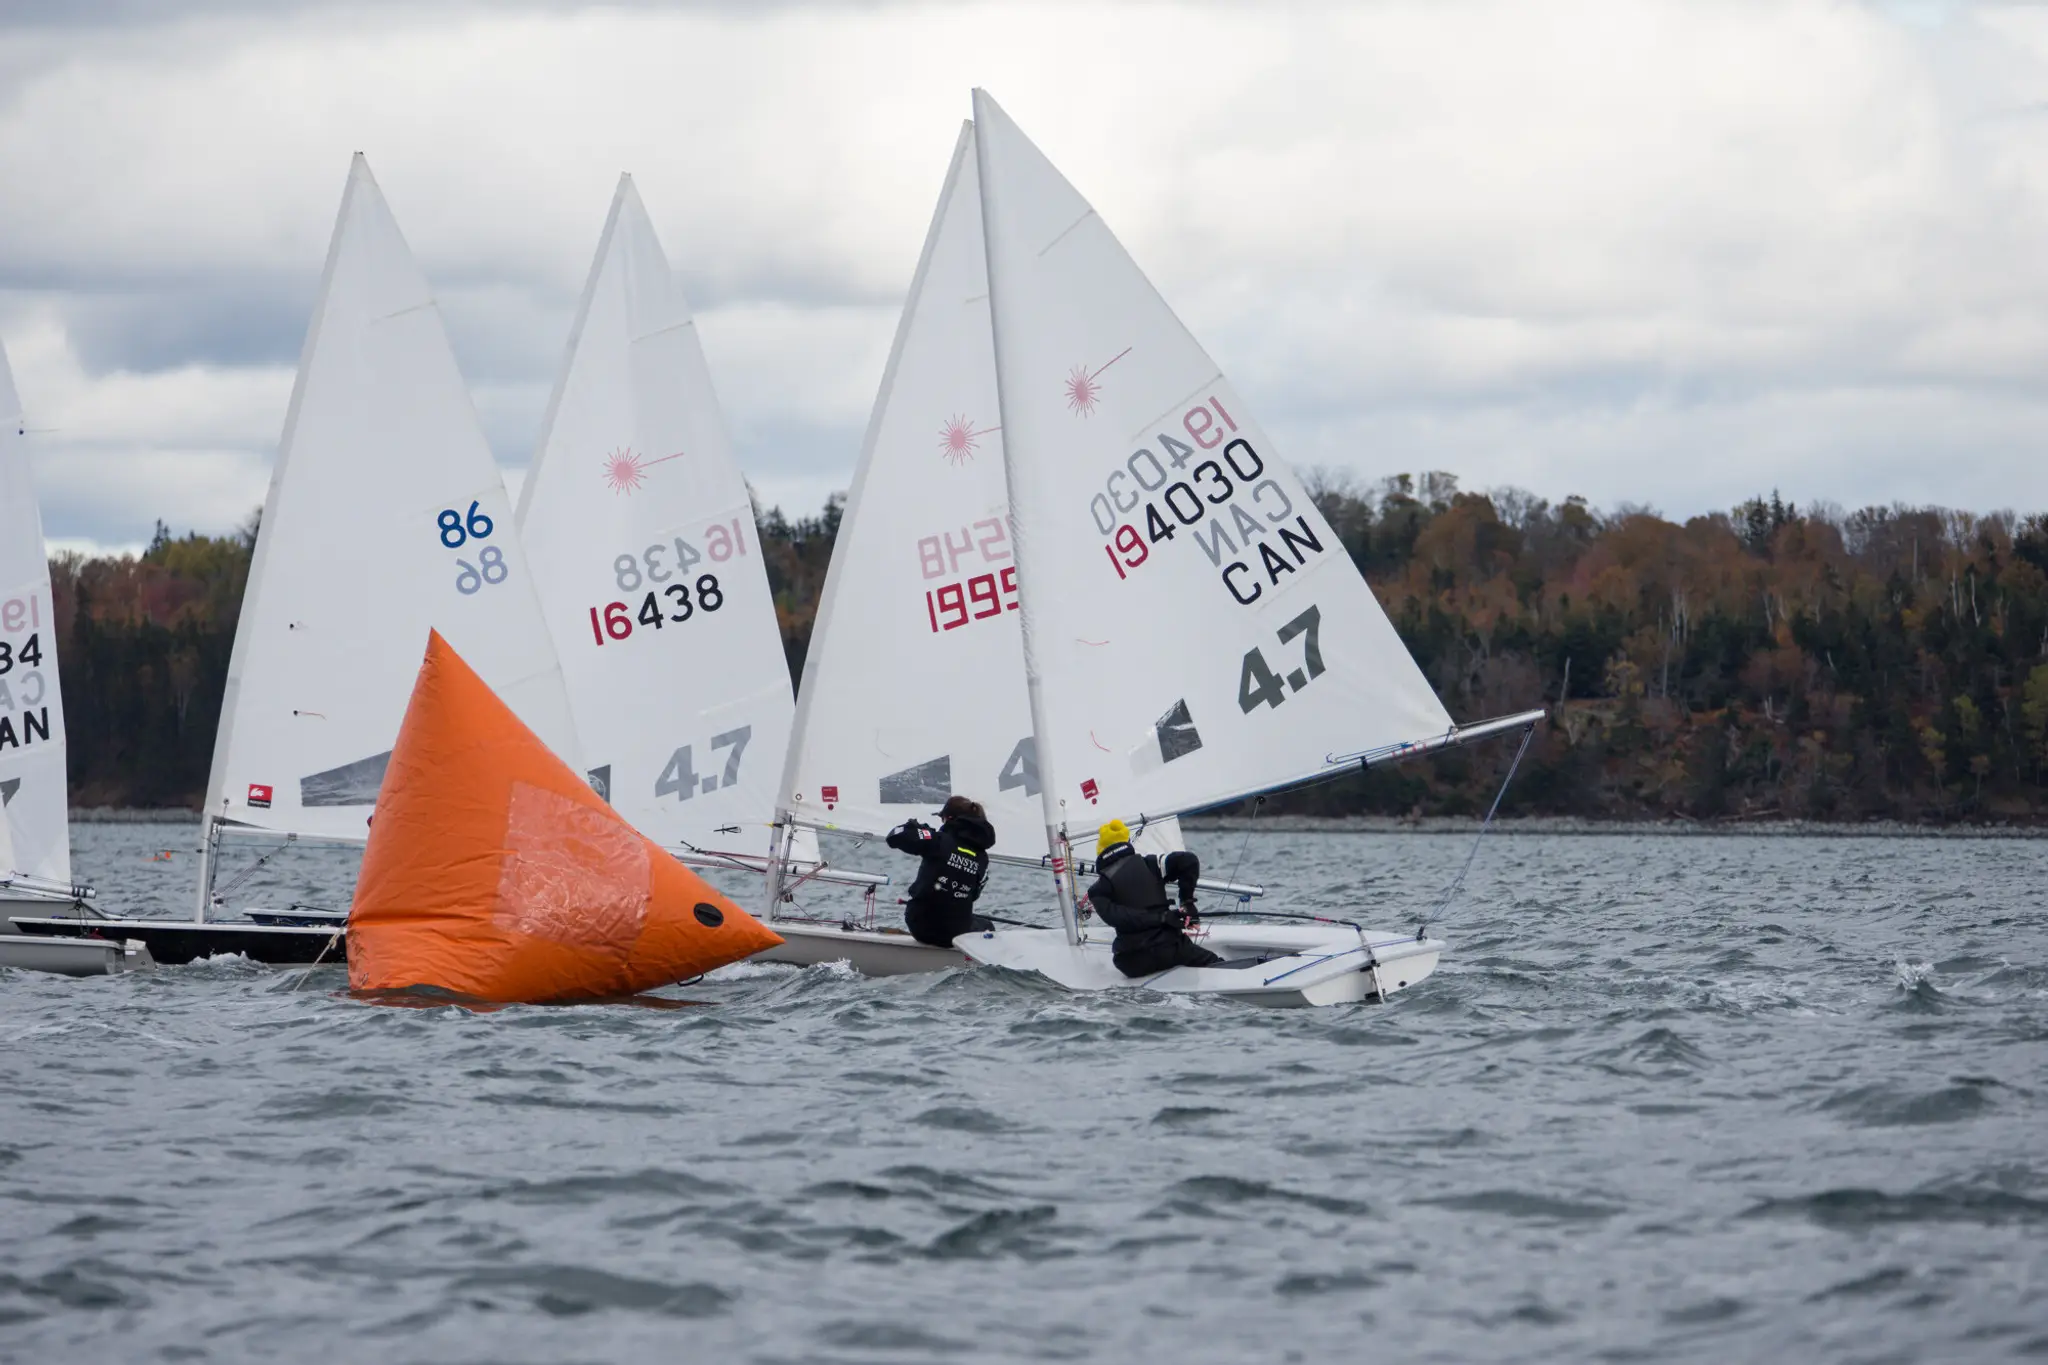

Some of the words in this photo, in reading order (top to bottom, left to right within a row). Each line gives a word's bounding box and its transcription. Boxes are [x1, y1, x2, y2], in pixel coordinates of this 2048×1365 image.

[437, 499, 494, 548] 86
[1105, 438, 1264, 580] 194030
[1222, 515, 1325, 605] CAN
[589, 573, 724, 646] 16438
[1238, 603, 1327, 715] 4.7
[654, 724, 752, 803] 4.7
